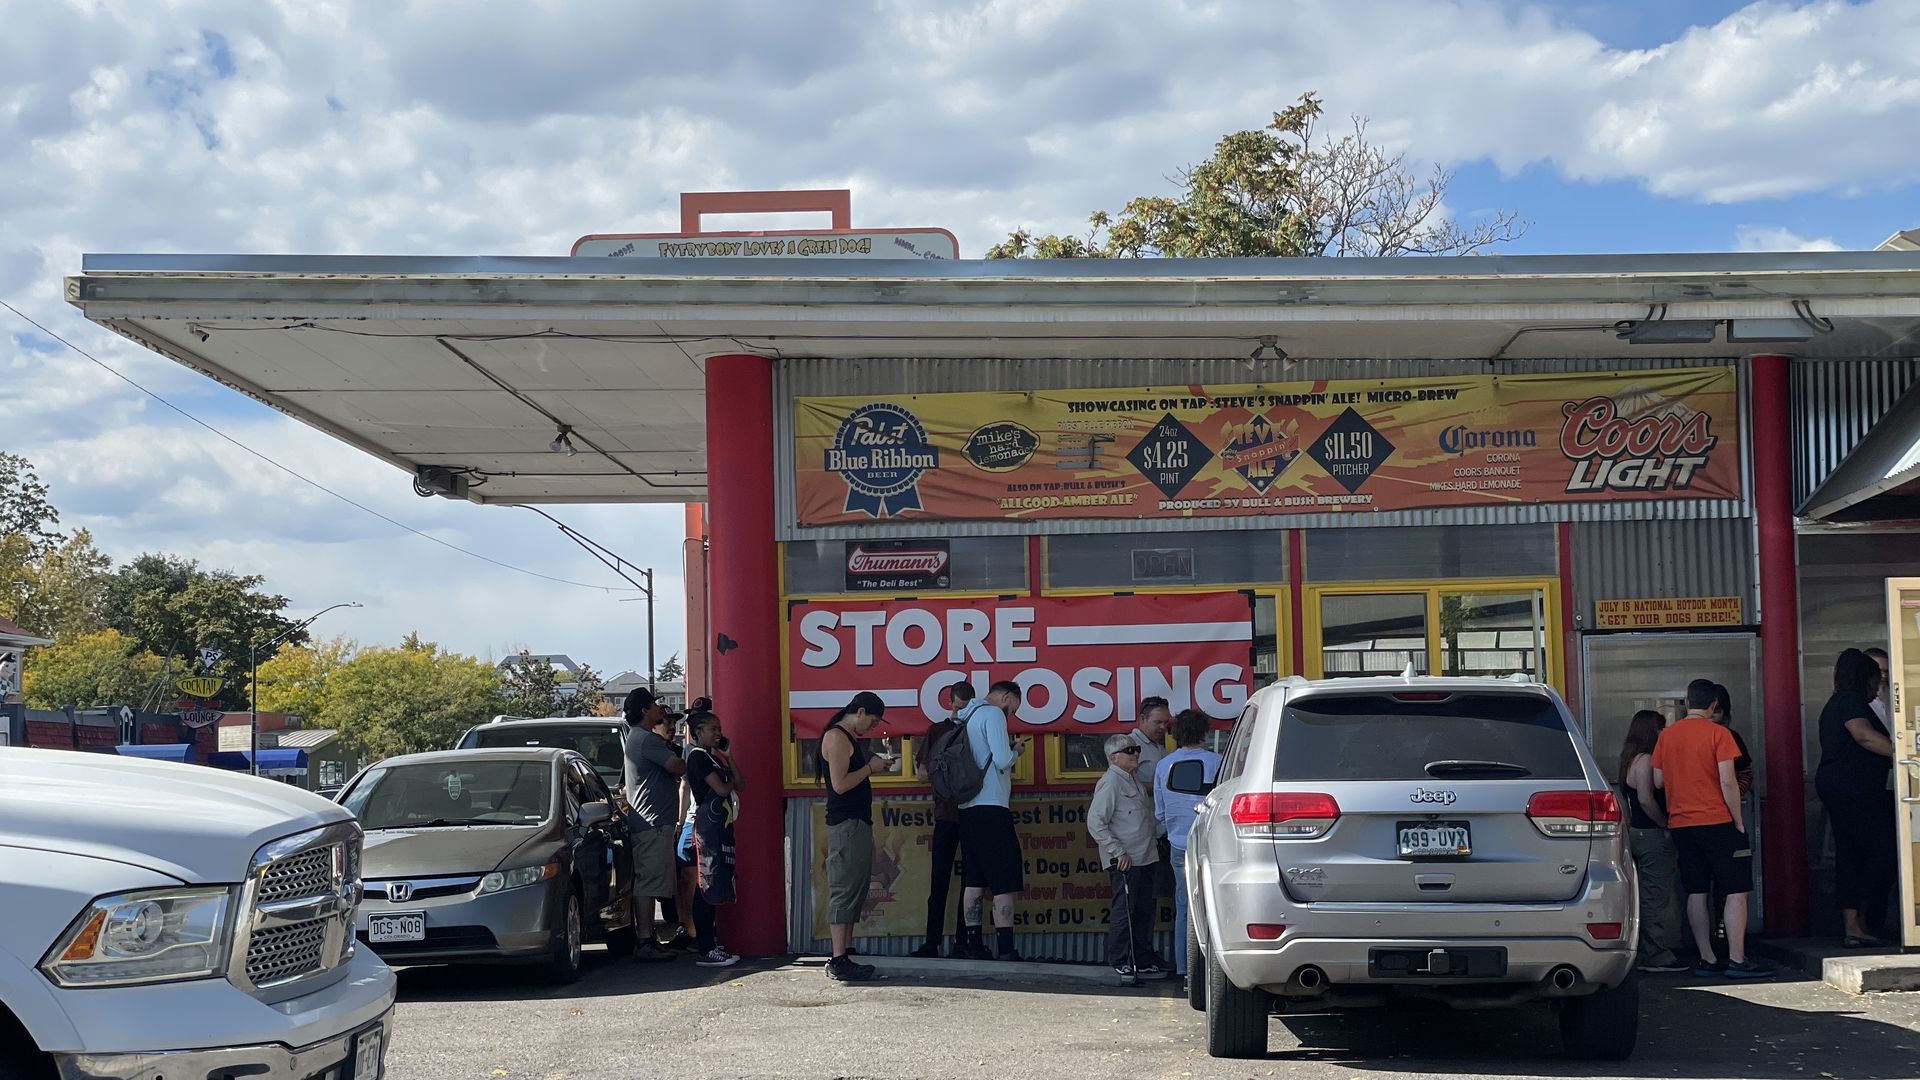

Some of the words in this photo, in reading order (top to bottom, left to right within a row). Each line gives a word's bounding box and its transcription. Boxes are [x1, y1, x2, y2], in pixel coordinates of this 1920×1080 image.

[658, 241, 741, 257] EVERYBODY
[743, 240, 785, 256] LOVES
[787, 240, 796, 255] A
[797, 238, 838, 256] GREAT
[839, 238, 872, 255] DOG!
[1068, 400, 1156, 413] SHOWCASING
[1159, 399, 1178, 410] ON
[1268, 393, 1328, 408] SNAPPIN'
[1331, 392, 1361, 405] ALE!
[1366, 389, 1458, 404] MICRO-BREW
[851, 417, 909, 446] Pabst
[1561, 396, 1718, 458] Coors
[975, 429, 1020, 446] mike's
[1439, 424, 1536, 456] Corona
[988, 441, 1020, 453] hard
[1324, 431, 1373, 462] $11.50
[828, 449, 868, 471] Blue
[870, 447, 936, 471] Ribbon
[977, 446, 1030, 466] lemonade
[1143, 441, 1188, 470] $4.25
[1486, 453, 1521, 463] CORONA
[867, 471, 898, 479] BEER
[1332, 464, 1370, 476] PITCHER
[1454, 467, 1481, 477] COORS
[1484, 465, 1521, 476] BANQUET
[1566, 457, 1705, 493] LIGHT
[1160, 472, 1179, 485] PINT
[1430, 482, 1454, 492] MIKES
[1456, 481, 1478, 490] HARD
[1479, 479, 1521, 489] LEMONADE
[1007, 484, 1028, 492] ALSO
[1030, 483, 1041, 491] ON
[1159, 499, 1221, 511] PRODUCED
[1223, 499, 1240, 509] BY
[1241, 497, 1271, 508] BULL
[1273, 497, 1283, 507] &
[1284, 496, 1315, 507] BUSH
[1317, 494, 1373, 505] BREWERY
[851, 555, 941, 571] Thumann's
[1599, 602, 1618, 612] JULY
[1622, 601, 1631, 611] IS
[1634, 600, 1672, 611] NATIONAL
[1676, 599, 1706, 610] HOTDOG
[1710, 598, 1739, 609] MONTH
[1608, 614, 1627, 625] GET
[1633, 613, 1660, 624] YOUR
[1665, 612, 1691, 623] DOGS
[1696, 611, 1730, 623] HERE!!
[800, 606, 1037, 668] STORE
[205, 651, 218, 661] PS
[181, 679, 217, 694] COCKTAIL
[184, 712, 215, 723] LOUNGE
[1410, 788, 1457, 806] Jeep
[1036, 859, 1070, 878] Dog
[1035, 908, 1052, 924] of
[1058, 908, 1084, 924] DU
